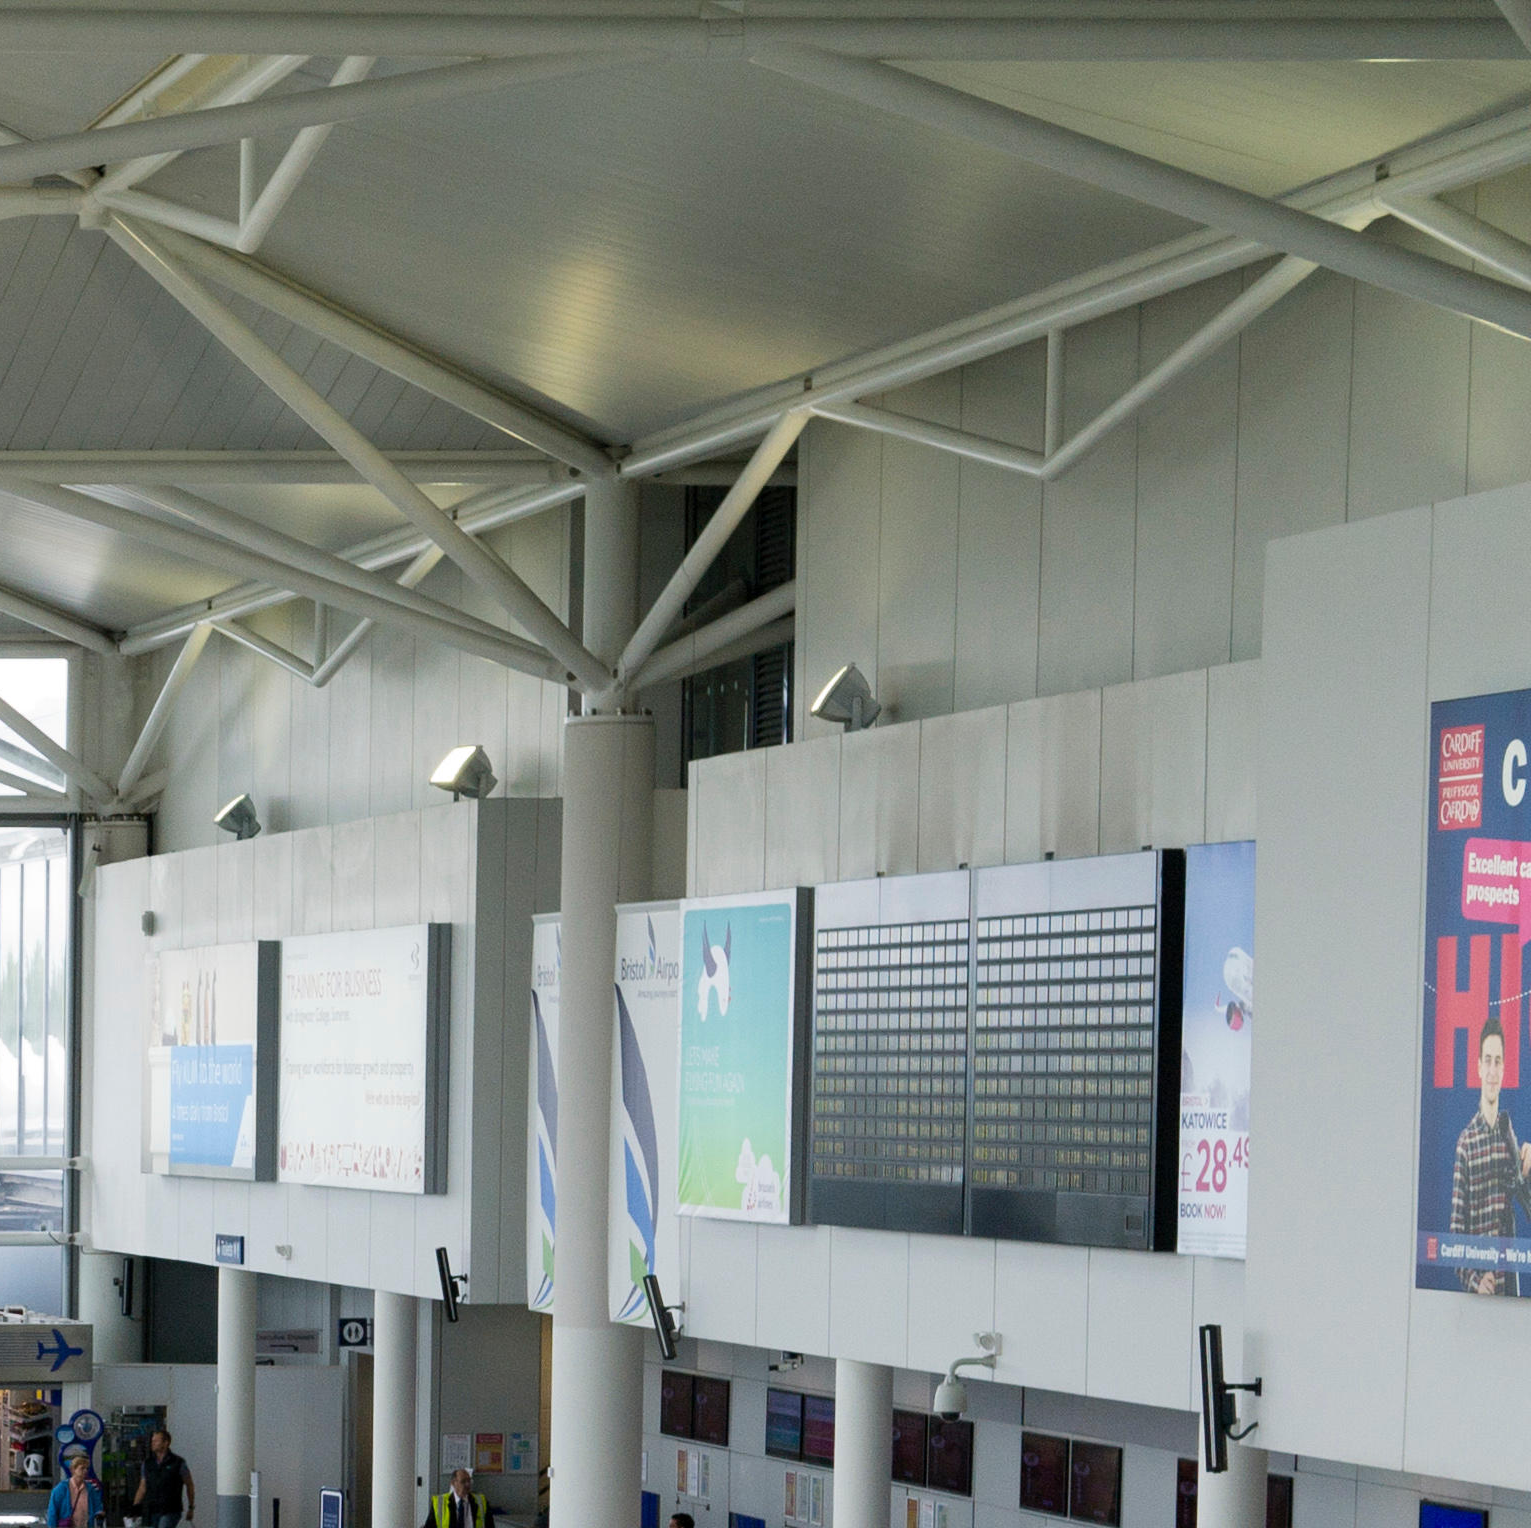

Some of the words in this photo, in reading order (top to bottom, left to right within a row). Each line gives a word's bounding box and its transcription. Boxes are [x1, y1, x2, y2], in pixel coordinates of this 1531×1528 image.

[1442, 730, 1482, 757] CARDIFF
[1443, 757, 1480, 772] UNIVERSITY
[1443, 784, 1478, 800] PRIFYSGOL
[1468, 852, 1517, 877] Excellent
[1466, 883, 1519, 906] prospects
[621, 956, 646, 981] Bristol
[286, 972, 324, 999] TRAINING
[327, 971, 342, 998] FOR
[345, 968, 382, 997] BUSINESS
[1435, 934, 1531, 1088] HI
[1181, 1112, 1227, 1130] KATOWICE
[1180, 1203, 1203, 1218] BOOK
[1204, 1204, 1226, 1219] NOW!
